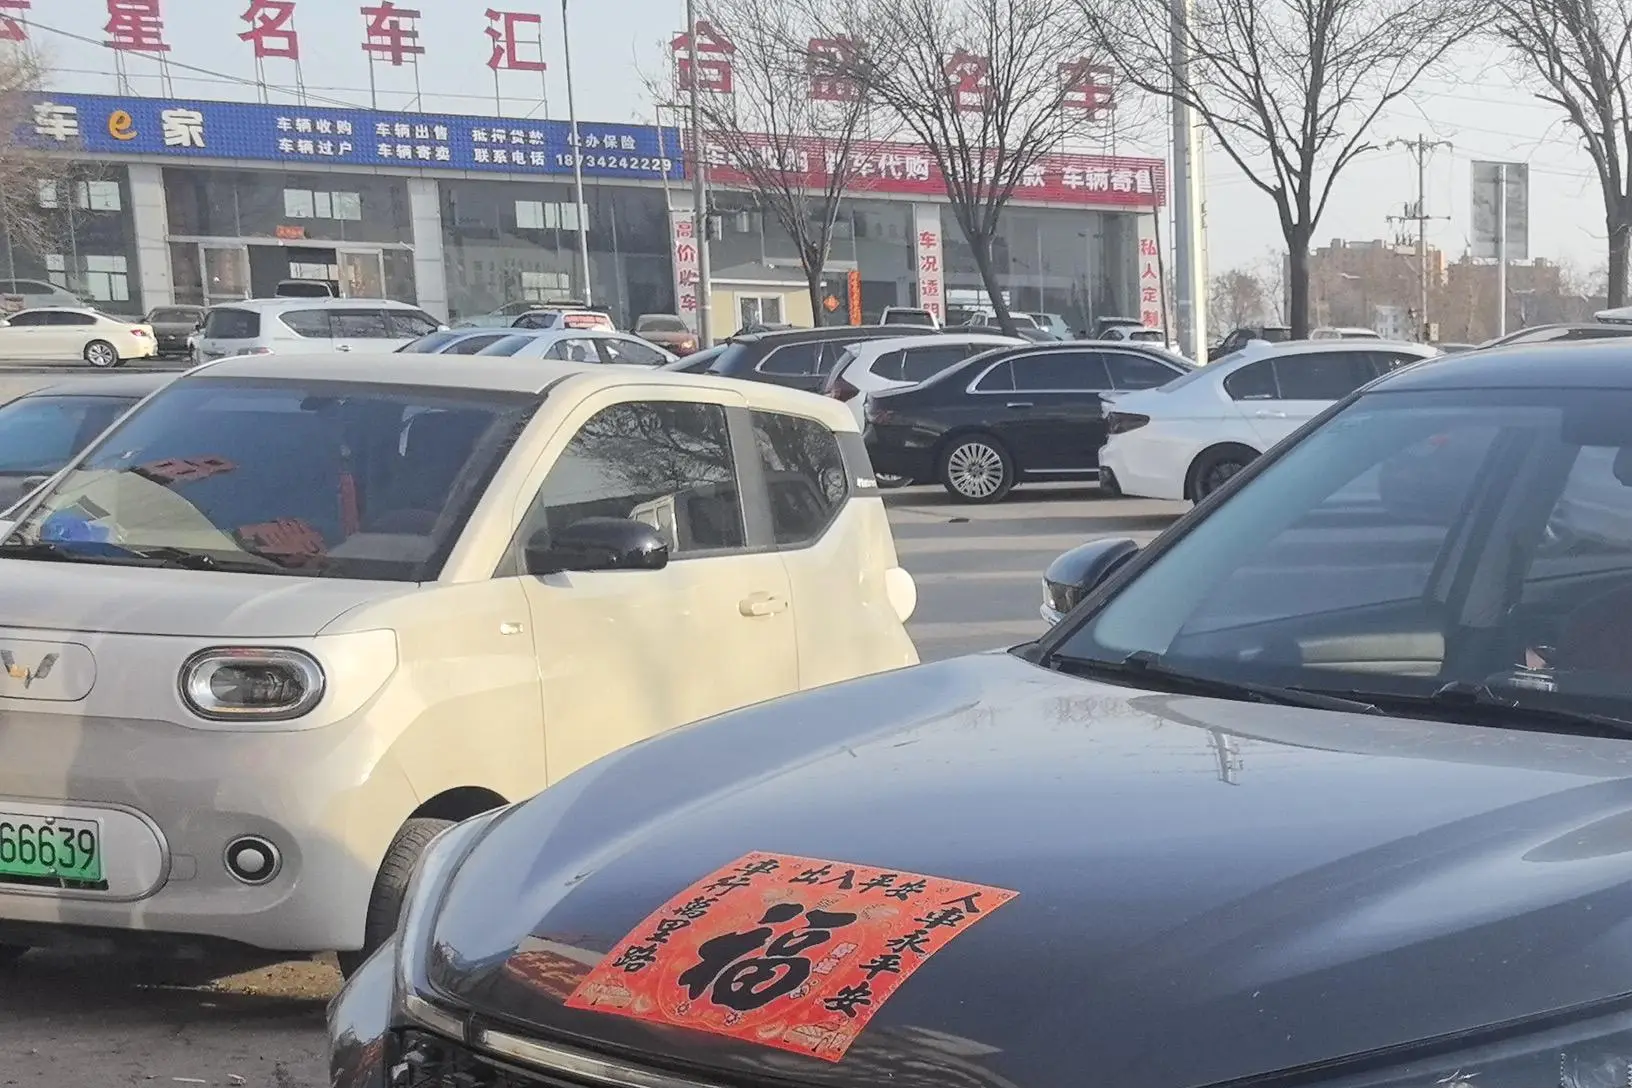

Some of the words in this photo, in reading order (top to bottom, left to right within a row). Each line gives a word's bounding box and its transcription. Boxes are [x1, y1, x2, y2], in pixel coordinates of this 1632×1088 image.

[276, 116, 353, 136] 车辆收购
[375, 122, 448, 141] 车辆出售
[471, 128, 545, 145] 抵押贷款
[278, 138, 353, 156] 车辆过户
[377, 143, 450, 161] 车辆寄卖
[474, 148, 546, 166] 联系电话
[1140, 238, 1159, 328] 私人定制
[0, 822, 96, 870] 66639
[788, 864, 927, 901] 出入平安
[677, 903, 858, 1012] 福
